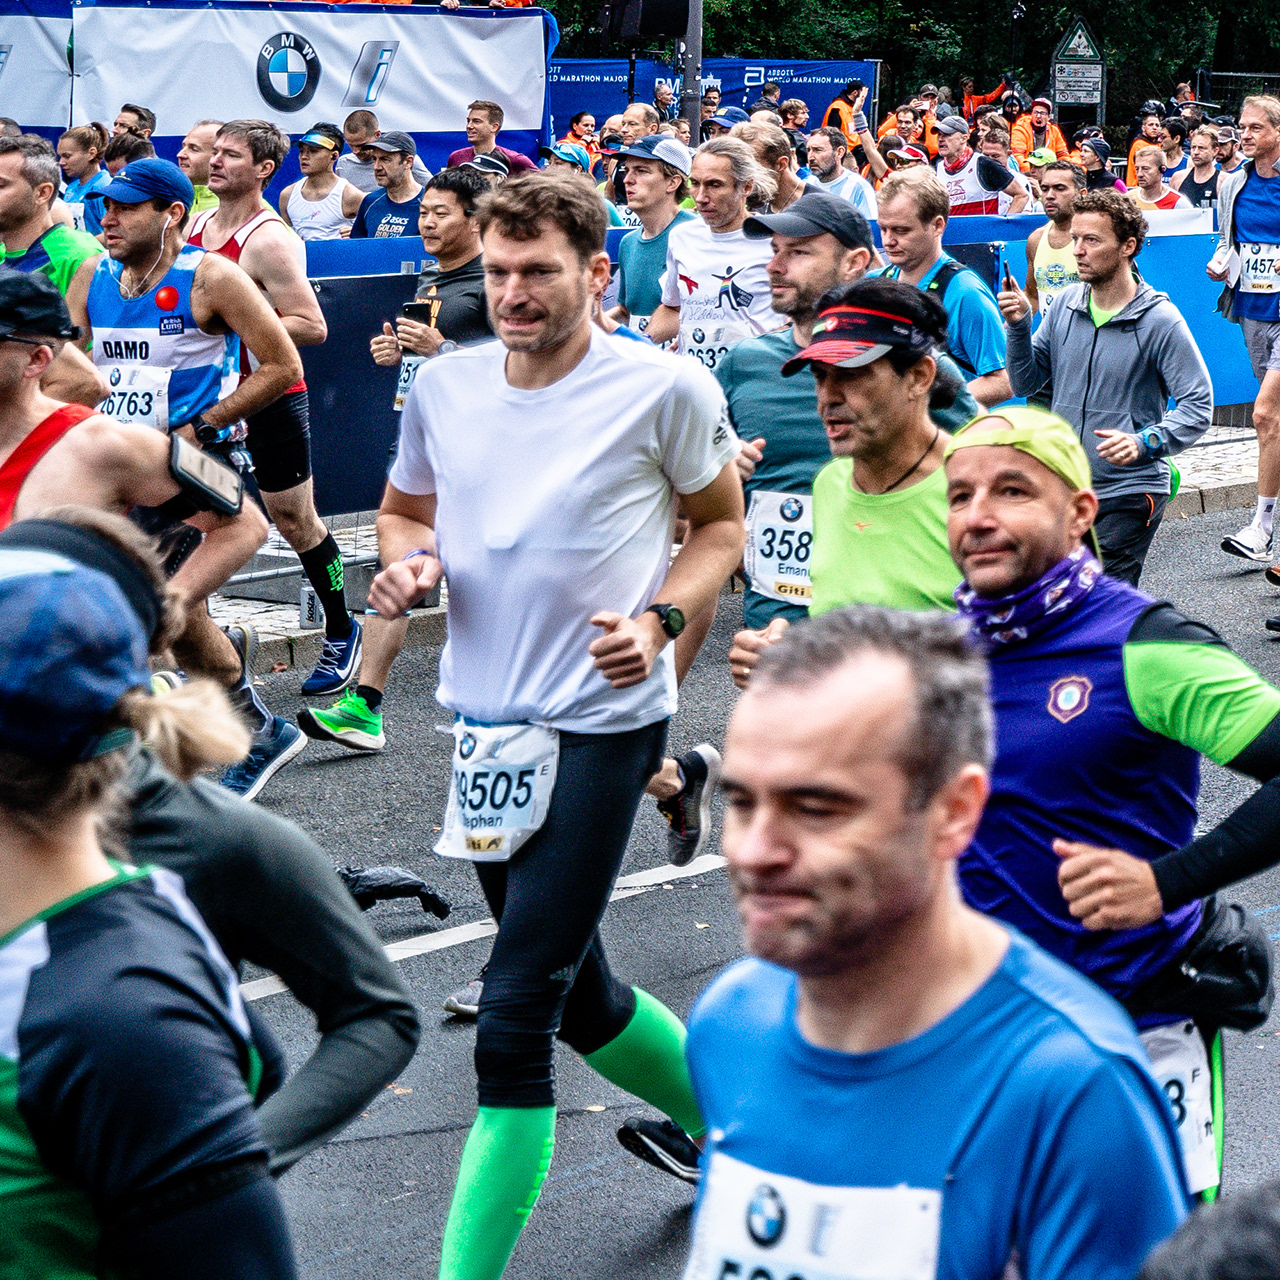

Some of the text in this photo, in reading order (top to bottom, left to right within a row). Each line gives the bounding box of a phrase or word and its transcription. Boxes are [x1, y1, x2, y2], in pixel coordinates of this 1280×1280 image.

[766, 69, 794, 77] ABBOTT
[560, 74, 601, 83] MARATHON
[603, 75, 628, 83] MAJOR
[792, 76, 832, 84] MARATHON
[389, 216, 409, 225] asics
[377, 224, 406, 234] GOLDEN
[161, 322, 183, 331] Lung
[102, 340, 150, 360] DAMO
[760, 527, 813, 563] 358
[777, 585, 806, 597] Giti
[456, 764, 550, 812] 9505 E
[463, 814, 504, 830] ephan
